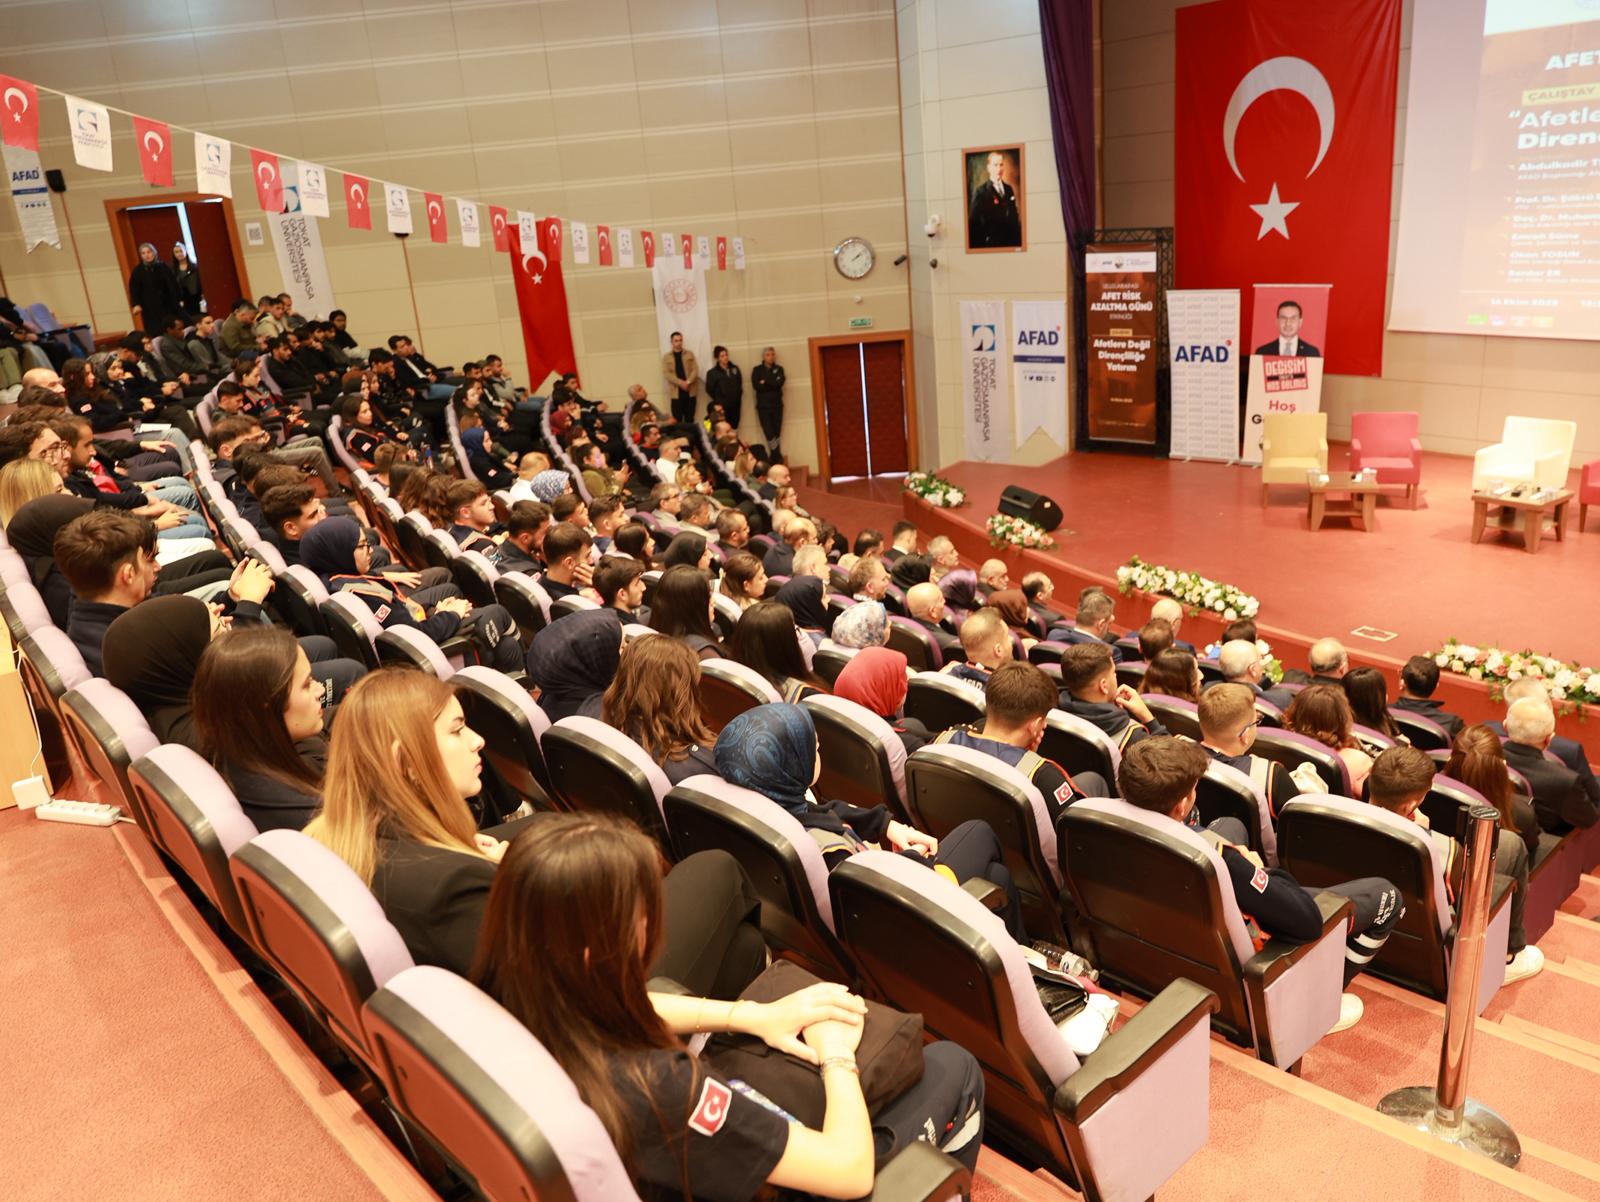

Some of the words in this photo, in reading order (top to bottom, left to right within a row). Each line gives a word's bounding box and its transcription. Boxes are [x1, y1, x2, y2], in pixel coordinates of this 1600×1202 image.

[1527, 86, 1596, 102] ÇALIŞTAY
[1517, 131, 1600, 150] Diren
[12, 169, 39, 182] AFAD
[297, 218, 312, 248] TOKAT
[1101, 291, 1121, 301] AFET
[1122, 289, 1141, 301] RİSK
[1090, 302, 1128, 312] AZALTMA
[1128, 300, 1153, 312] GÜNÜ
[1017, 330, 1059, 346] AFAD
[1093, 339, 1126, 348] Afetlere
[1127, 339, 1151, 351] Değil
[1175, 345, 1229, 363] AFAD
[989, 357, 997, 391] TOKAT
[1106, 362, 1138, 372] Yatırım
[1269, 399, 1297, 414] Hoş
